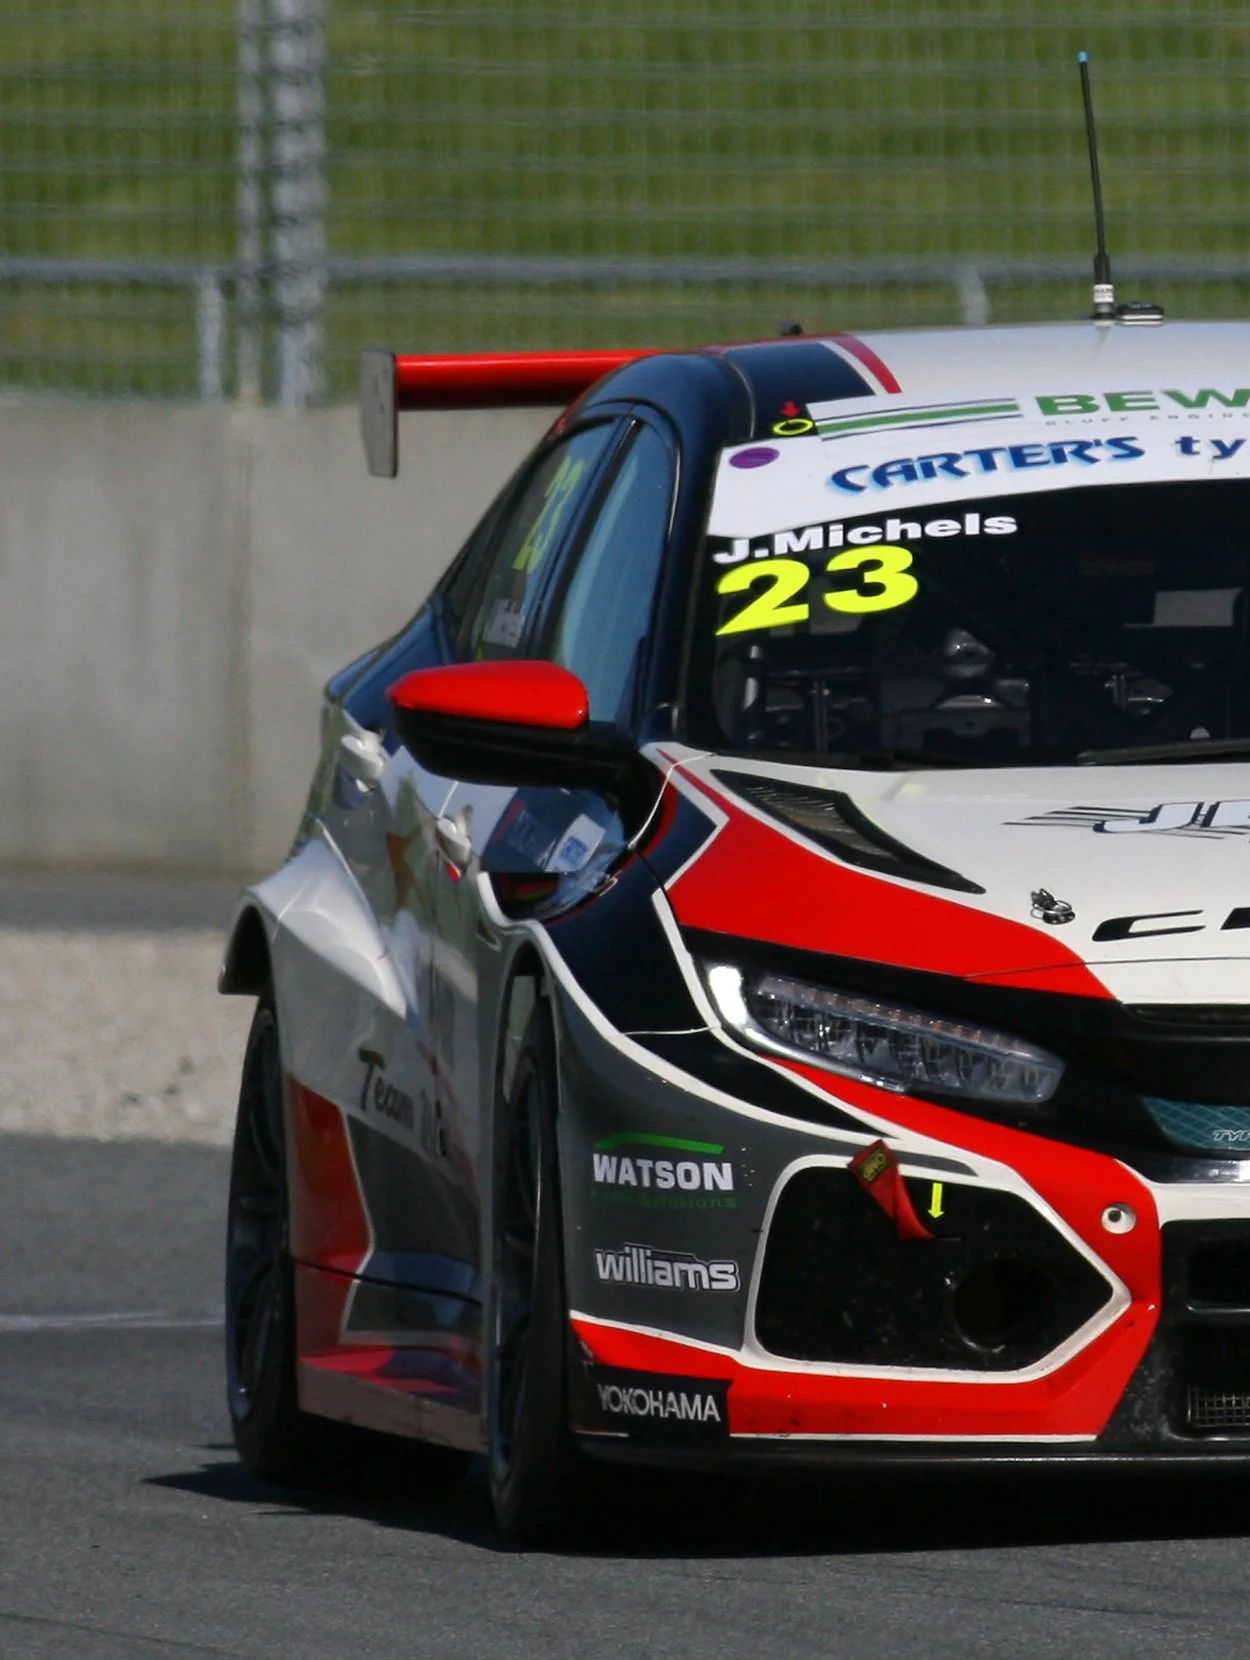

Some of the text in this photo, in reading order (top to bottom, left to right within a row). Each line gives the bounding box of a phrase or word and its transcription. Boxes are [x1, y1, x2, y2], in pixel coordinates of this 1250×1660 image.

[826, 436, 1145, 493] CARTER'S
[713, 512, 1018, 565] J.Michels
[715, 545, 919, 636] 23
[592, 1153, 734, 1191] WATSON
[597, 1244, 738, 1291] williams
[599, 1383, 721, 1422] YOKOHAMA
